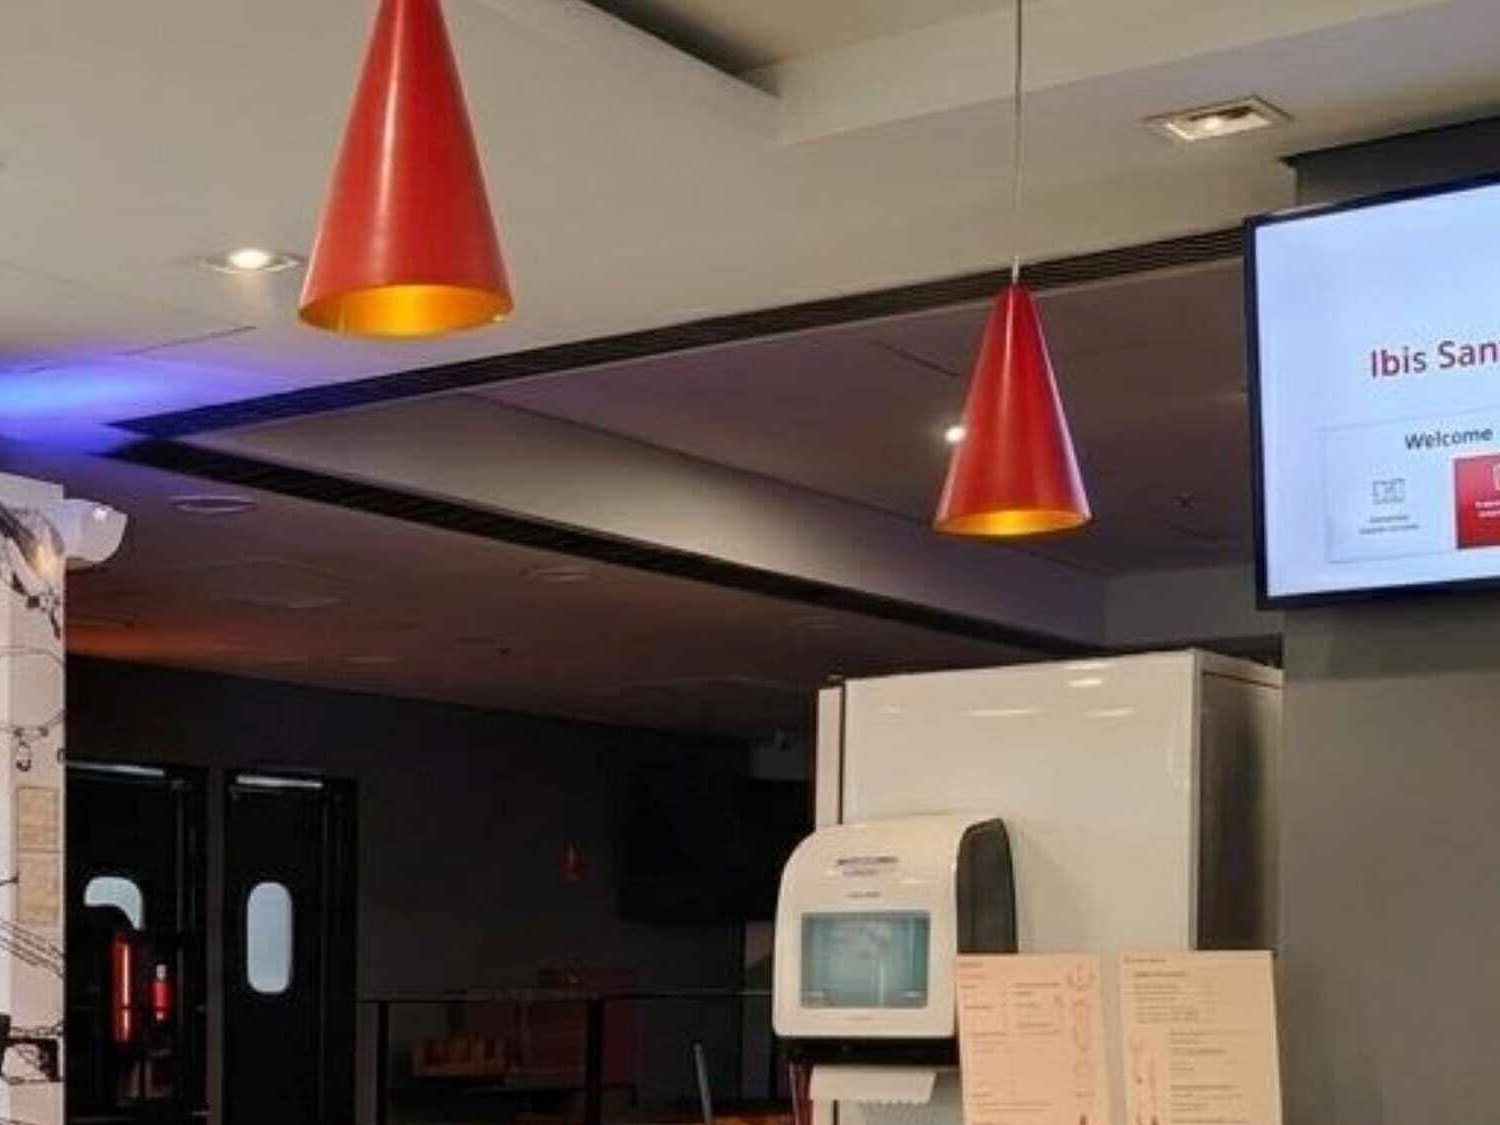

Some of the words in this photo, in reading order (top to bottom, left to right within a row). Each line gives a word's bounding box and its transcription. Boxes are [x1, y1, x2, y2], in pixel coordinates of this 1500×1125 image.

[1371, 346, 1427, 379] Ibis
[1437, 340, 1500, 369] San
[1404, 429, 1494, 450] Welcome
